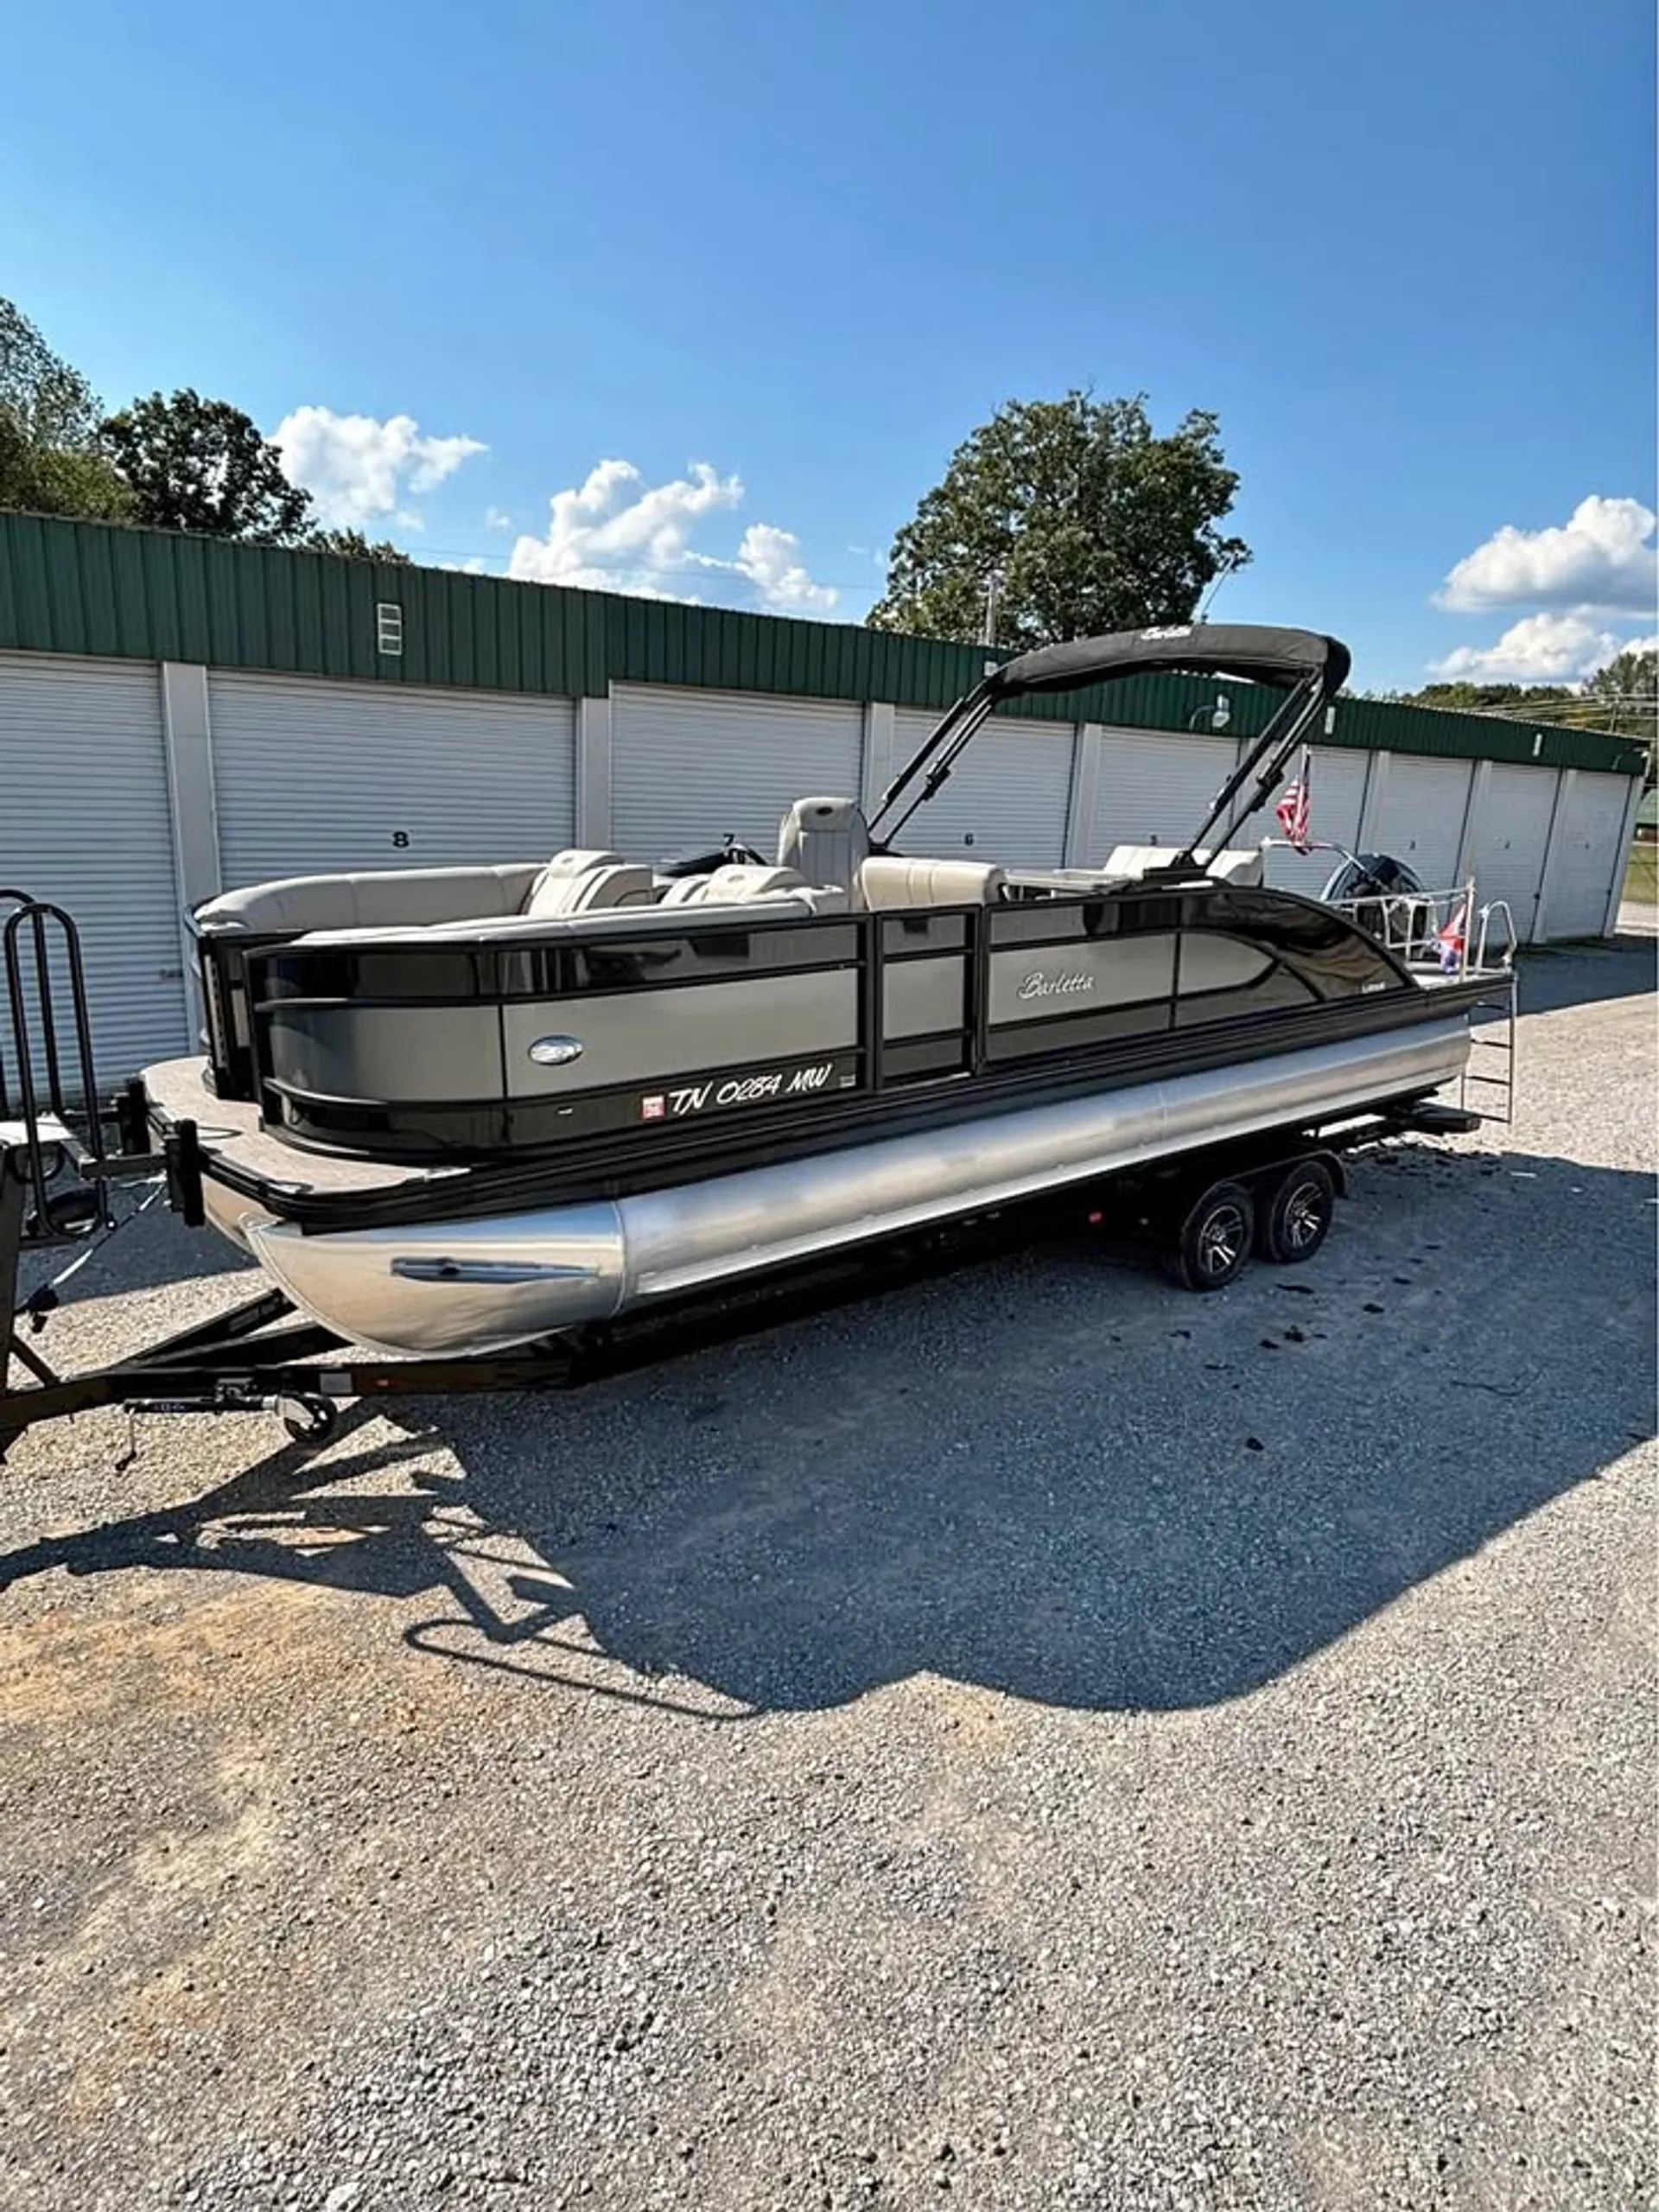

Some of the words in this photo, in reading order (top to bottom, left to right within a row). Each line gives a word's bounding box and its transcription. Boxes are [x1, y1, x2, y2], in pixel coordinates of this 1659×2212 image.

[393, 831, 409, 848] 8
[723, 833, 734, 847] 7
[965, 833, 973, 846] 6
[669, 1081, 713, 1115] TN
[716, 1074, 783, 1104] 0284
[785, 1063, 832, 1093] MW
